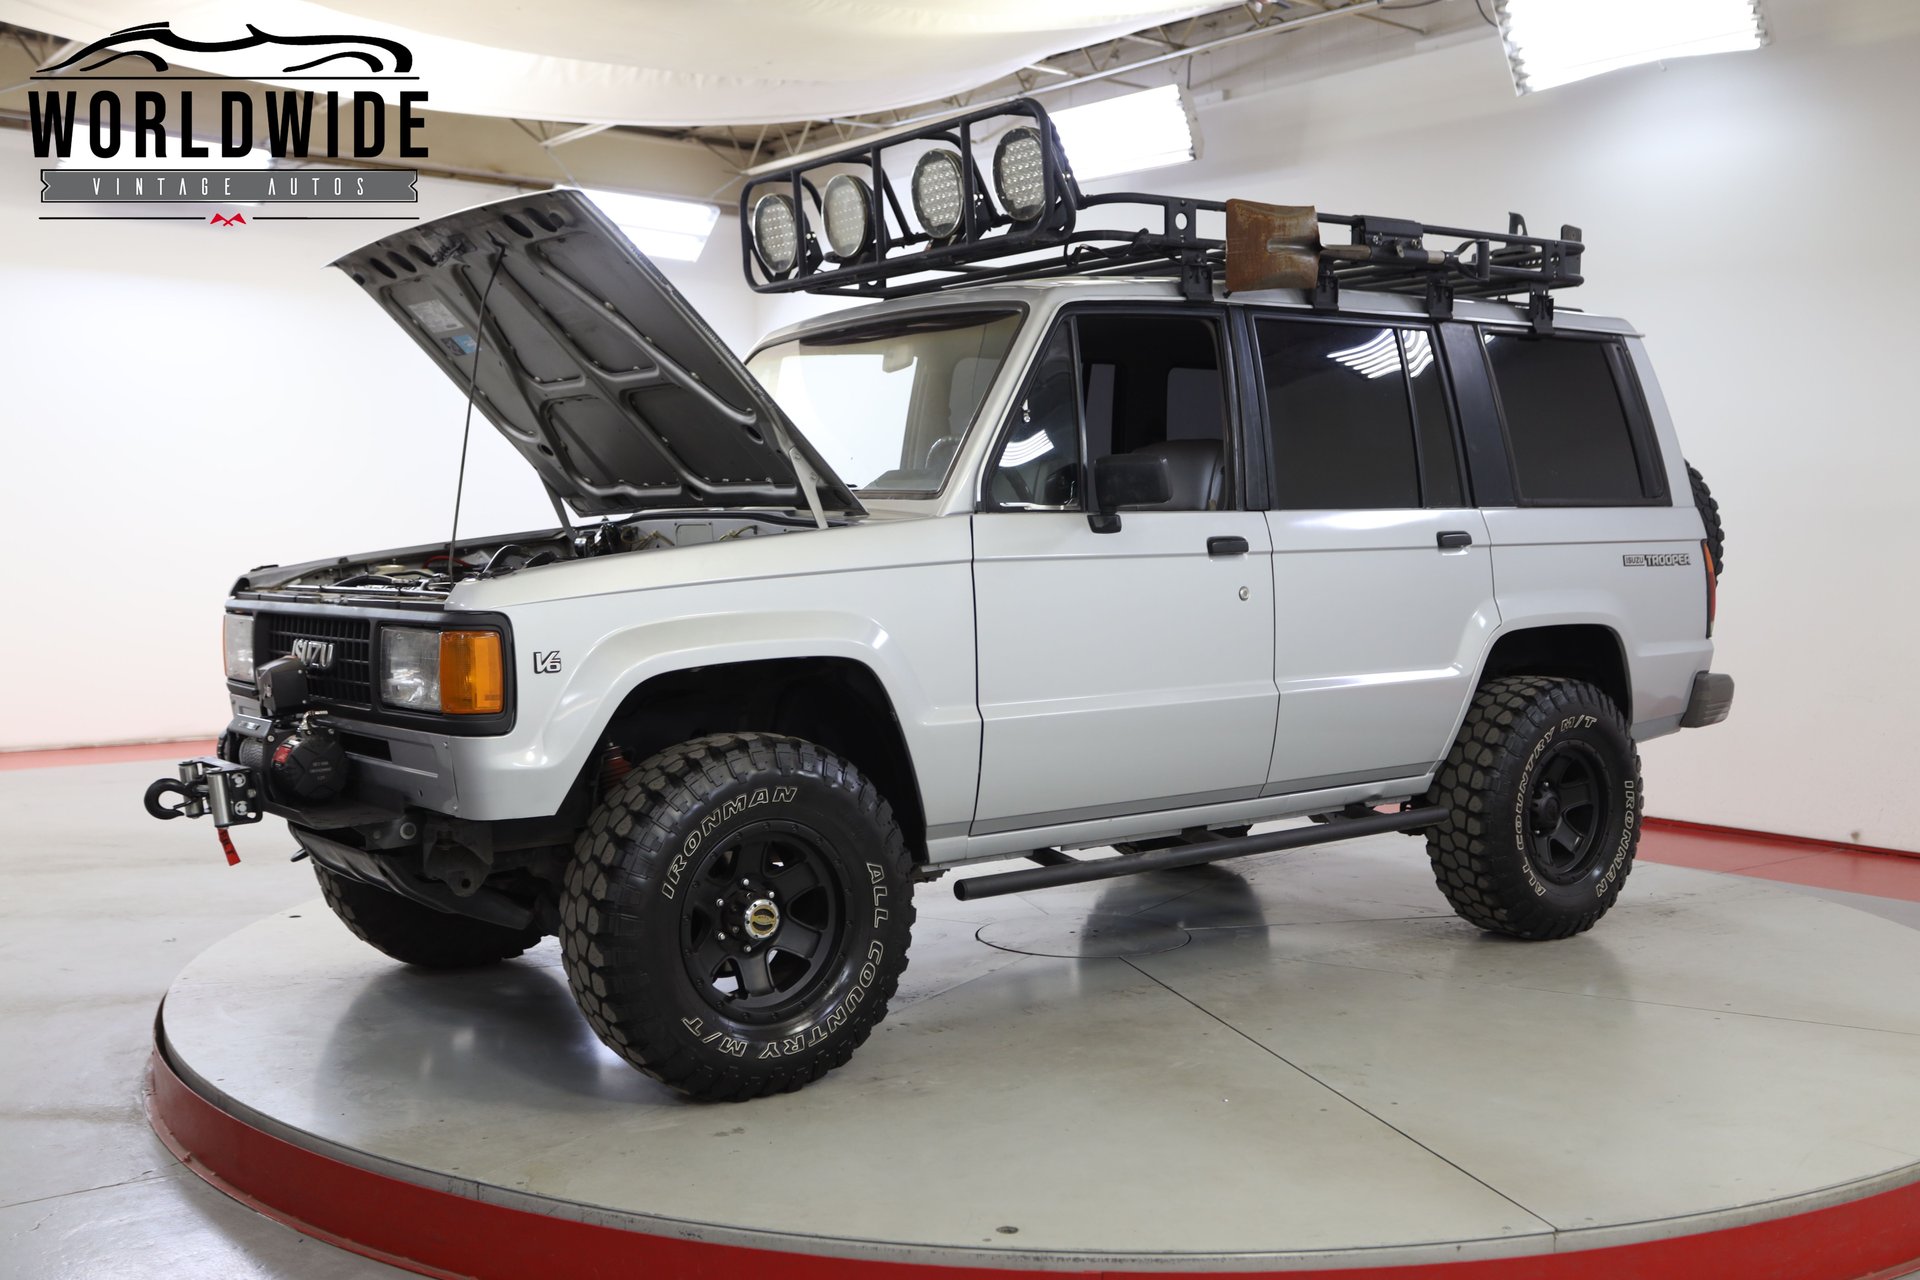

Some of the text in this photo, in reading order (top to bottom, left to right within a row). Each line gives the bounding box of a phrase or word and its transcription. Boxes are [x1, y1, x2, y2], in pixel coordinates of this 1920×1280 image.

[1645, 553, 1691, 566] TROOPER
[533, 650, 561, 674] V6
[661, 786, 798, 900] IRONMAN
[1515, 715, 1597, 896] ALL COUNTRY M/T
[1596, 780, 1635, 897] IRONMAN
[680, 862, 888, 1059] ALL COUNTRY M/T
